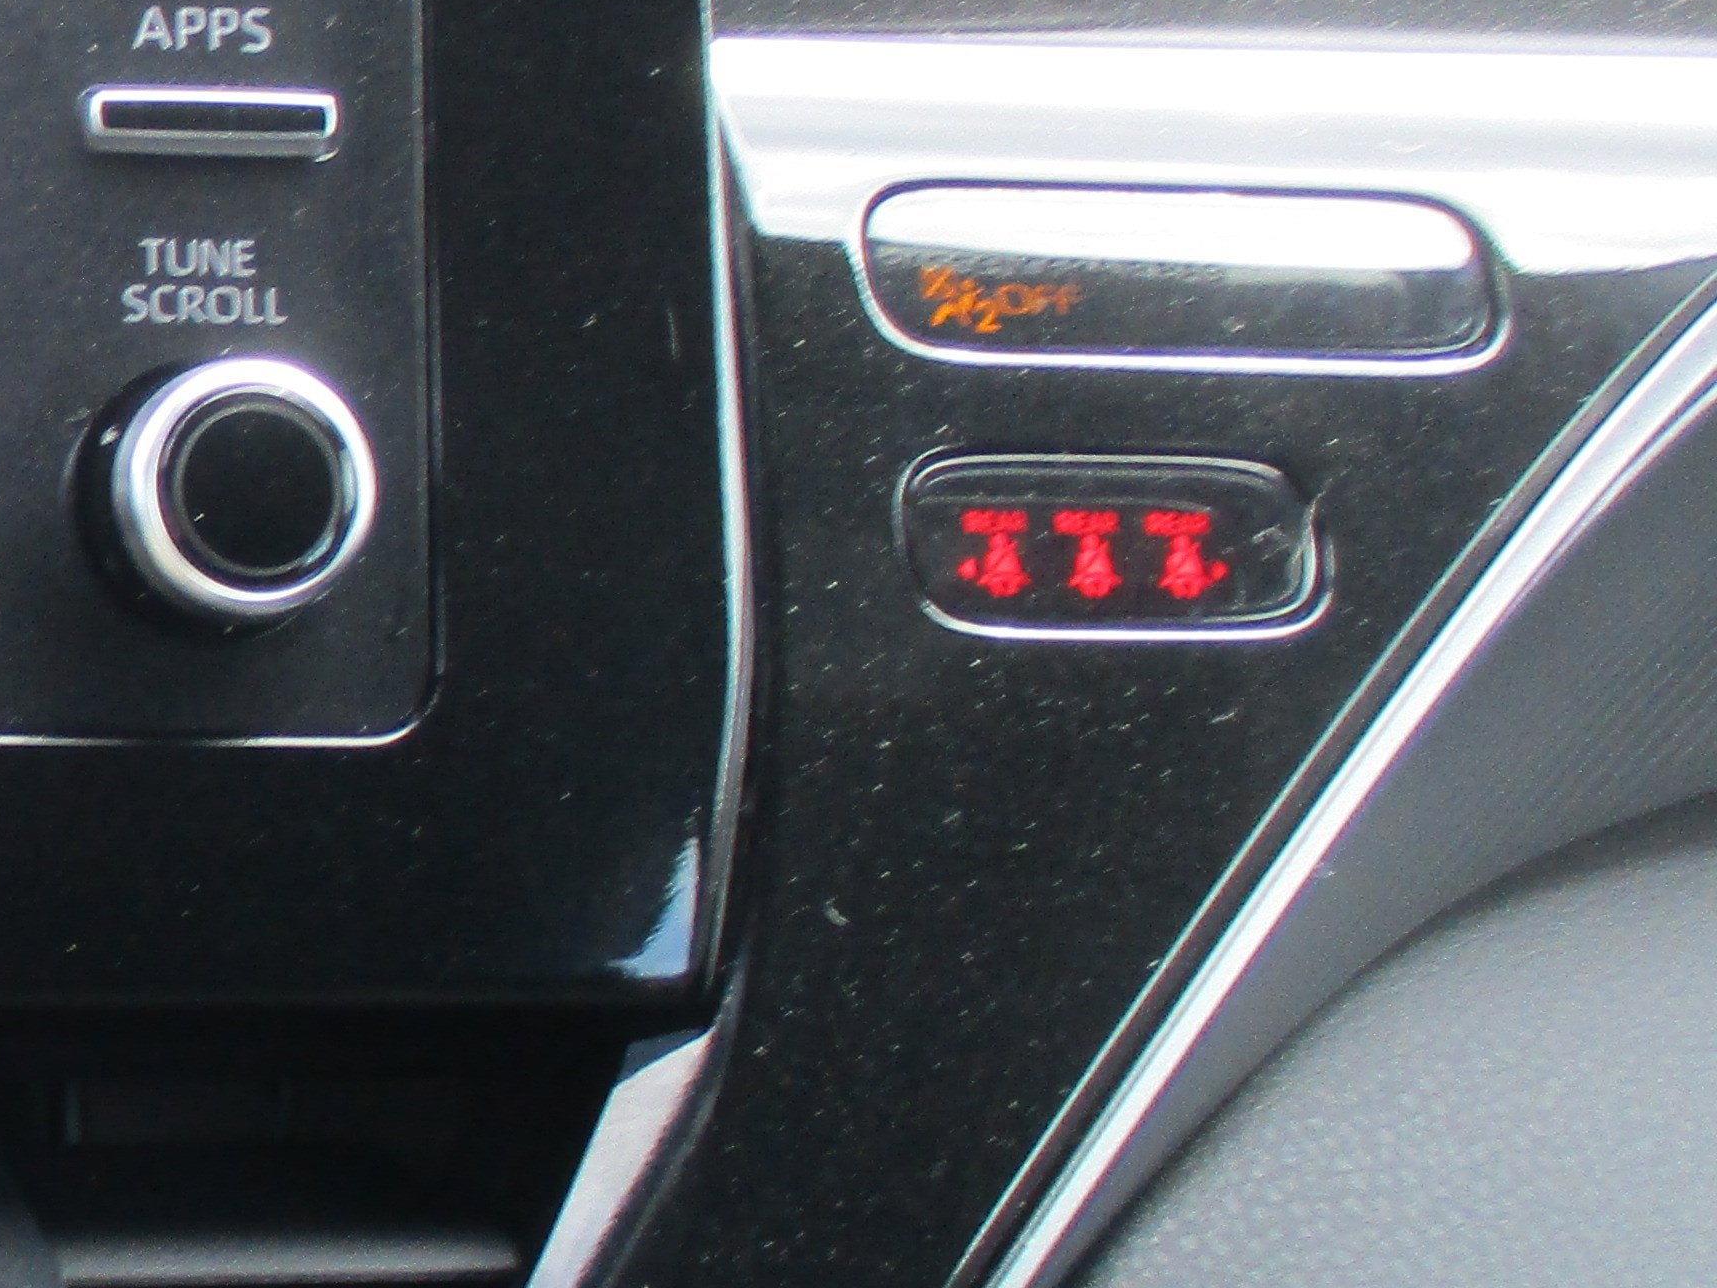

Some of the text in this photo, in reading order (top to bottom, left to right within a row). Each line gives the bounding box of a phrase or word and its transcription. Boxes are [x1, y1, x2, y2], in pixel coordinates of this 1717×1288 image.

[131, 5, 274, 55] APPS
[138, 237, 257, 279] TUNE
[121, 283, 289, 327] SCROLL
